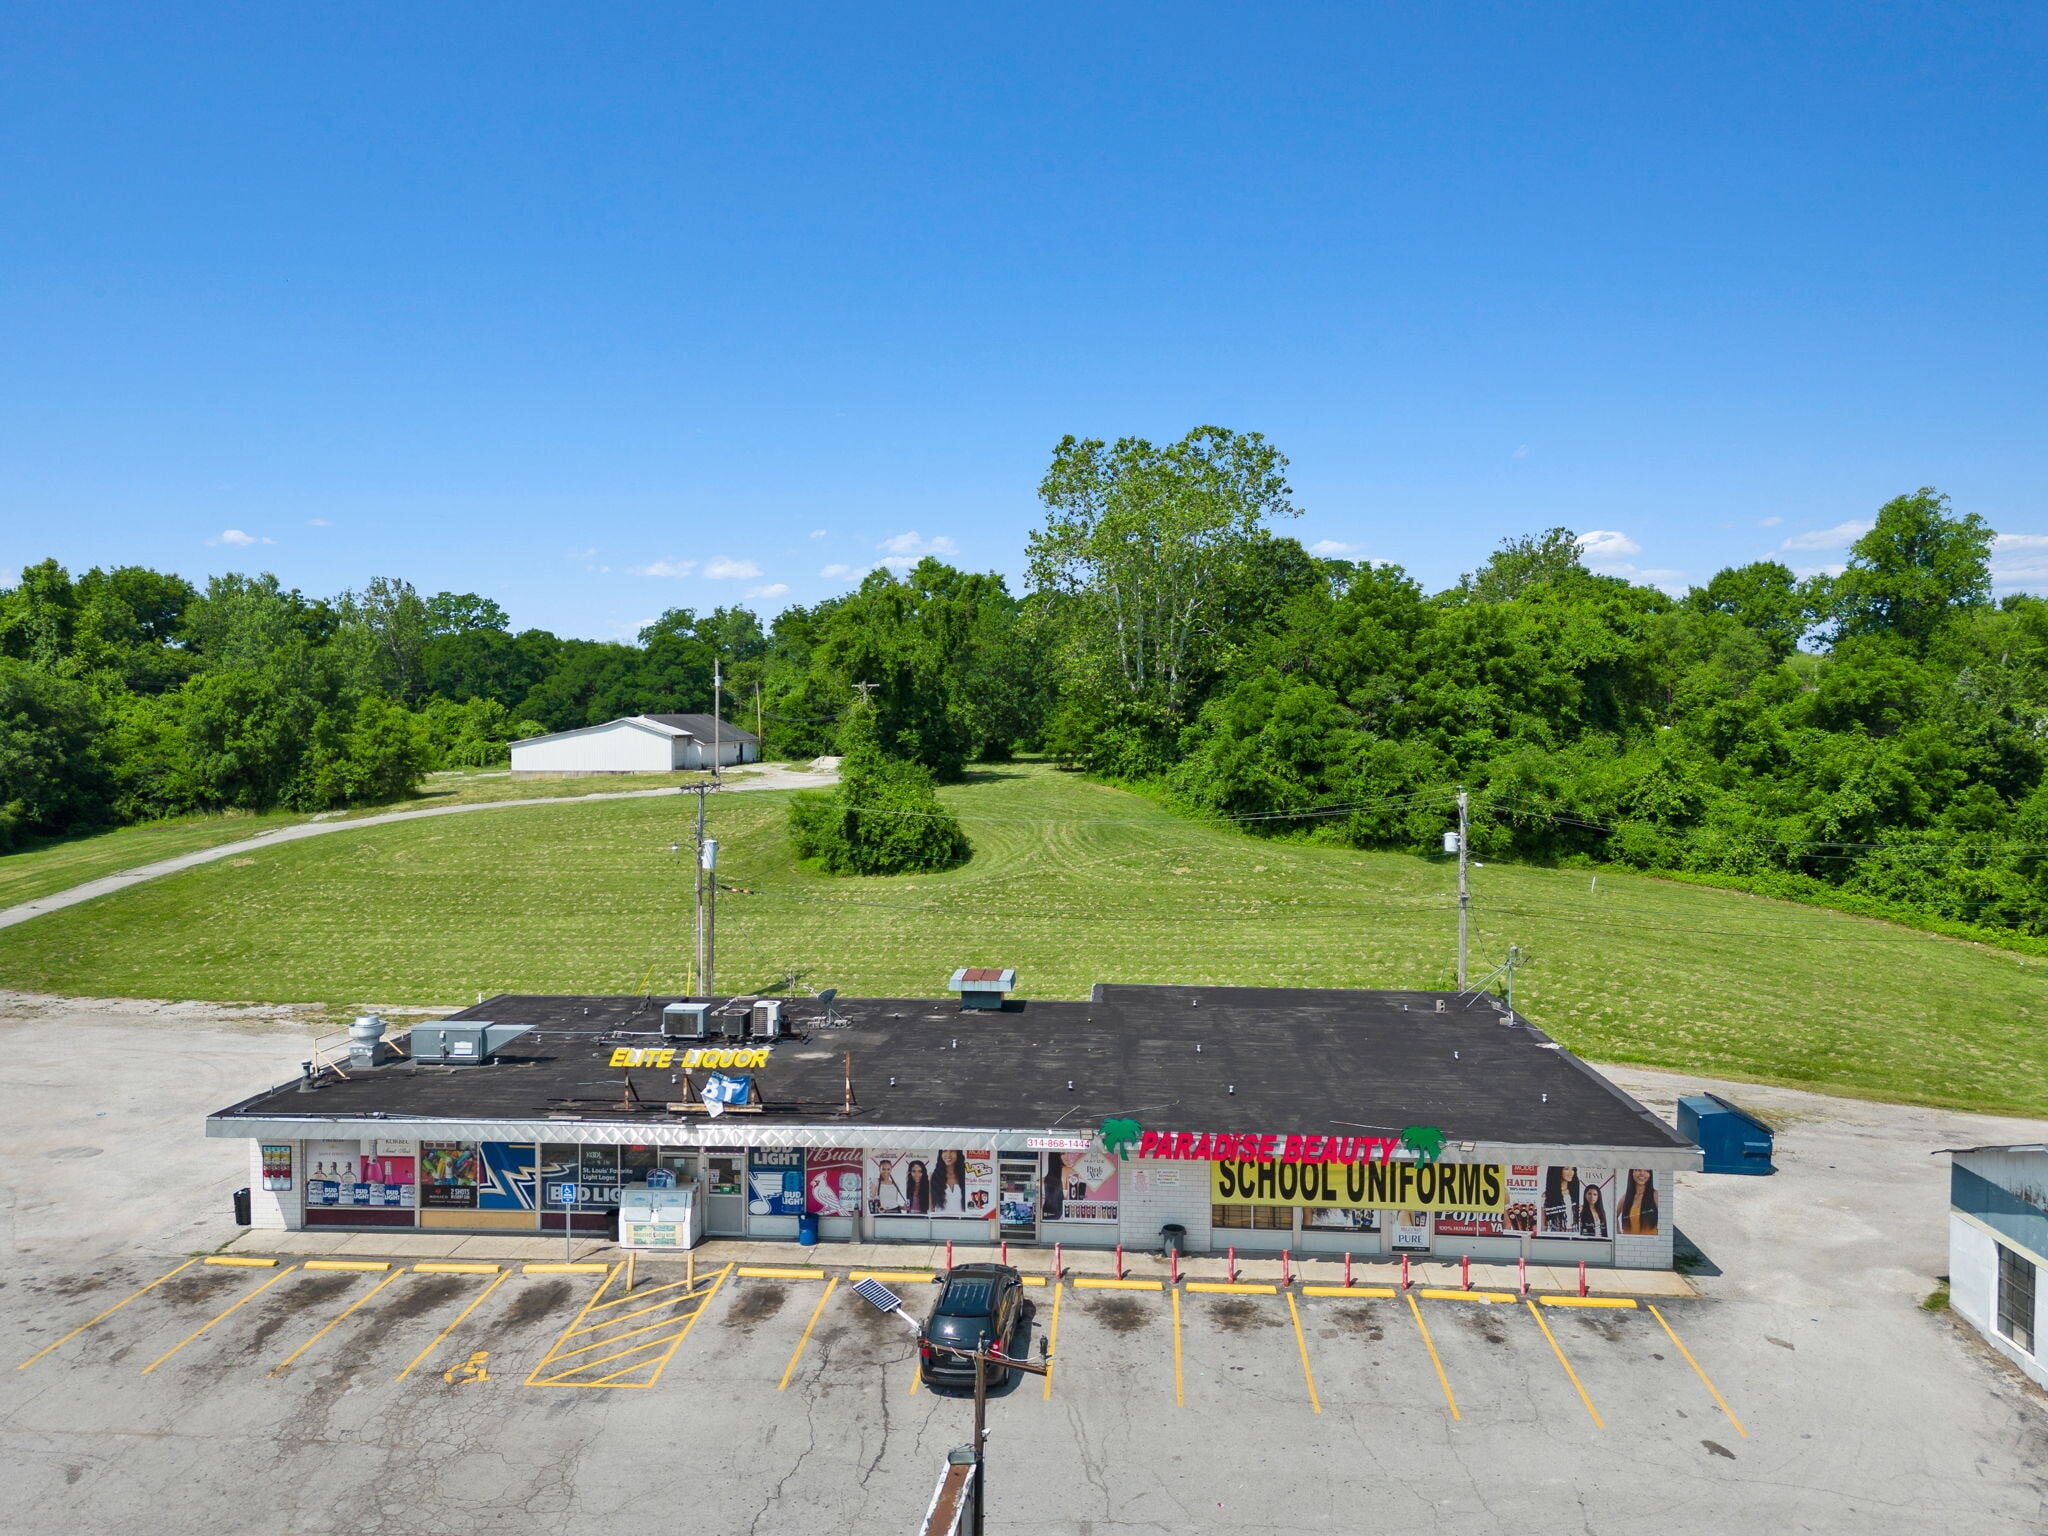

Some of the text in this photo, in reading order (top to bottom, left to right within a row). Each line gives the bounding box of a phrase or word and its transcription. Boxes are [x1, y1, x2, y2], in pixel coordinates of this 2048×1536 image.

[609, 1048, 770, 1069] ELITE LIQUOR
[1282, 1135, 1399, 1166] BEAUTY
[753, 1153, 800, 1166] LIGHT
[609, 1167, 633, 1175] Faorite
[1218, 1156, 1500, 1206] SCHOOL UNIFORMS
[455, 1188, 471, 1196] SHOTS
[550, 1186, 591, 1202] BD
[592, 1187, 620, 1202] LIG
[784, 1190, 801, 1198] BUD
[782, 1197, 804, 1206] LIGHT
[1398, 1233, 1422, 1244] PURE
